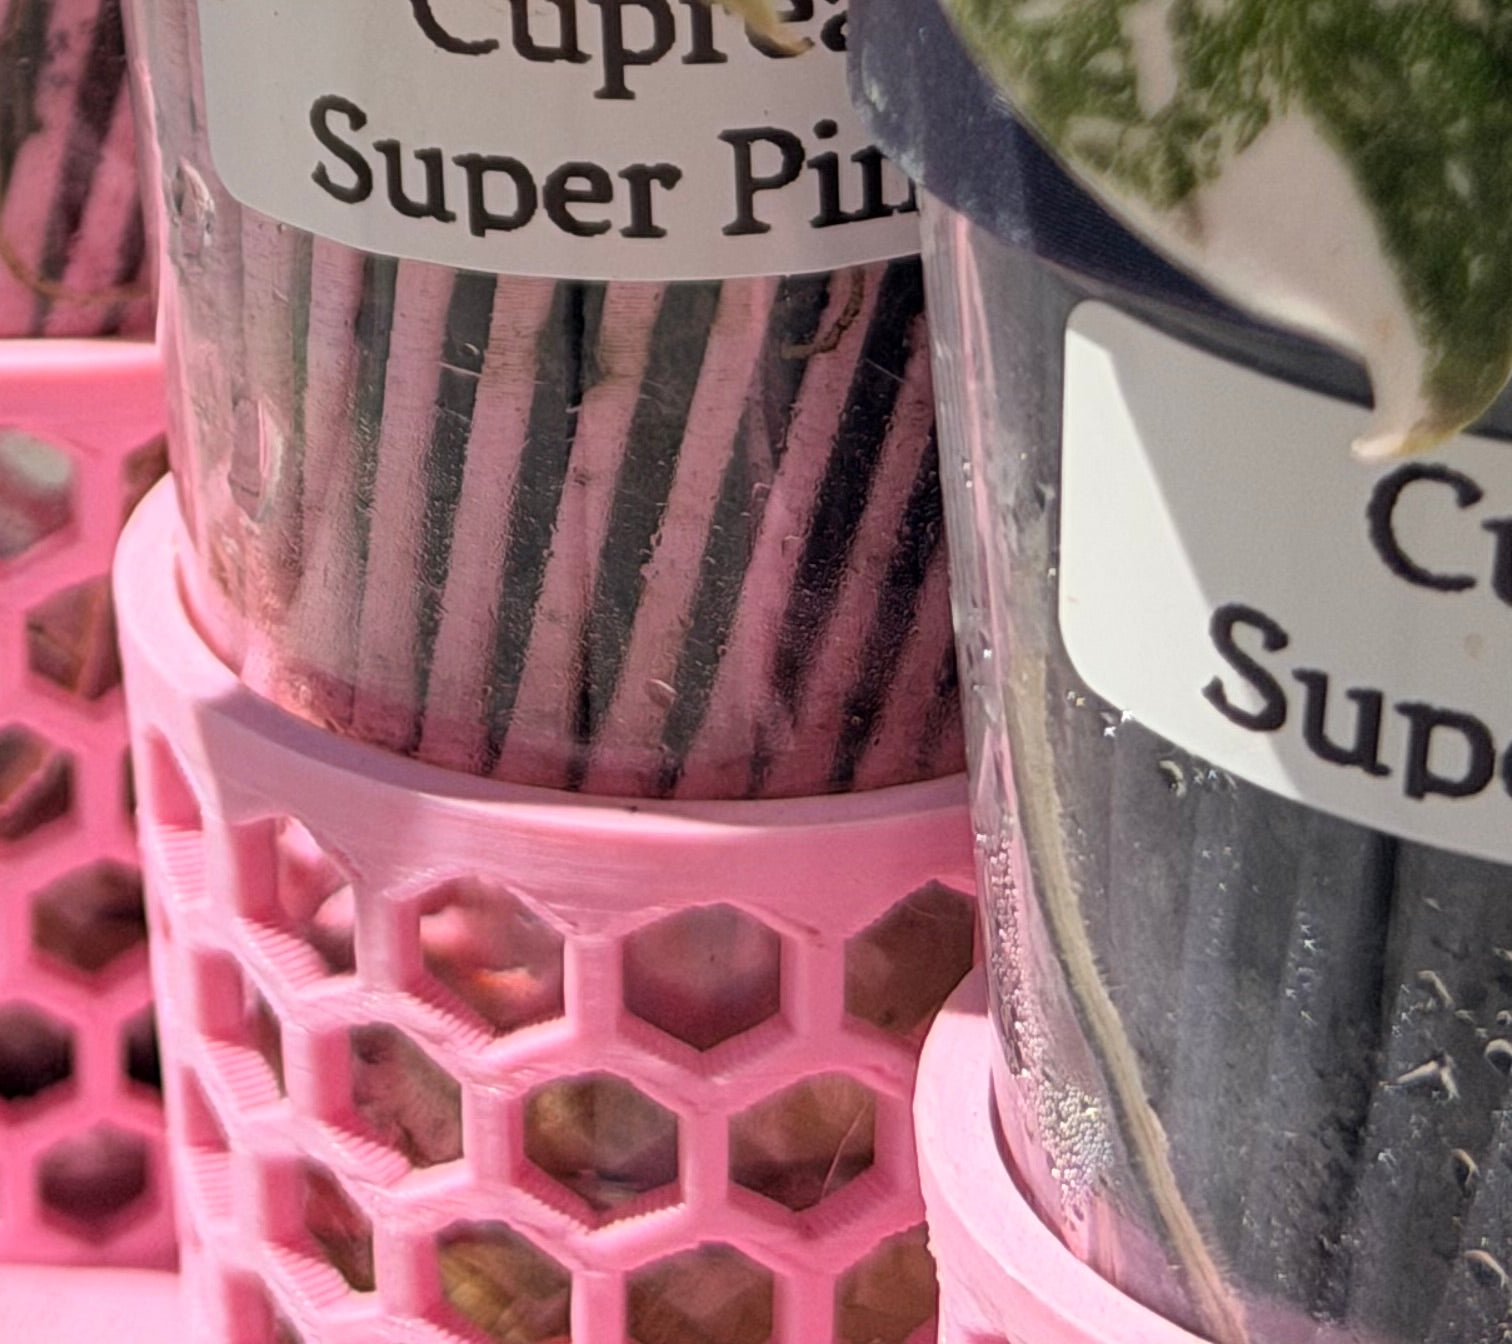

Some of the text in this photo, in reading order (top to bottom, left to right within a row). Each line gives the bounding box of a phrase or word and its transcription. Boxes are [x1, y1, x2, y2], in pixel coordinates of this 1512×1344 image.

[308, 93, 920, 239] Super Pin
[1200, 603, 1512, 801] Sup
